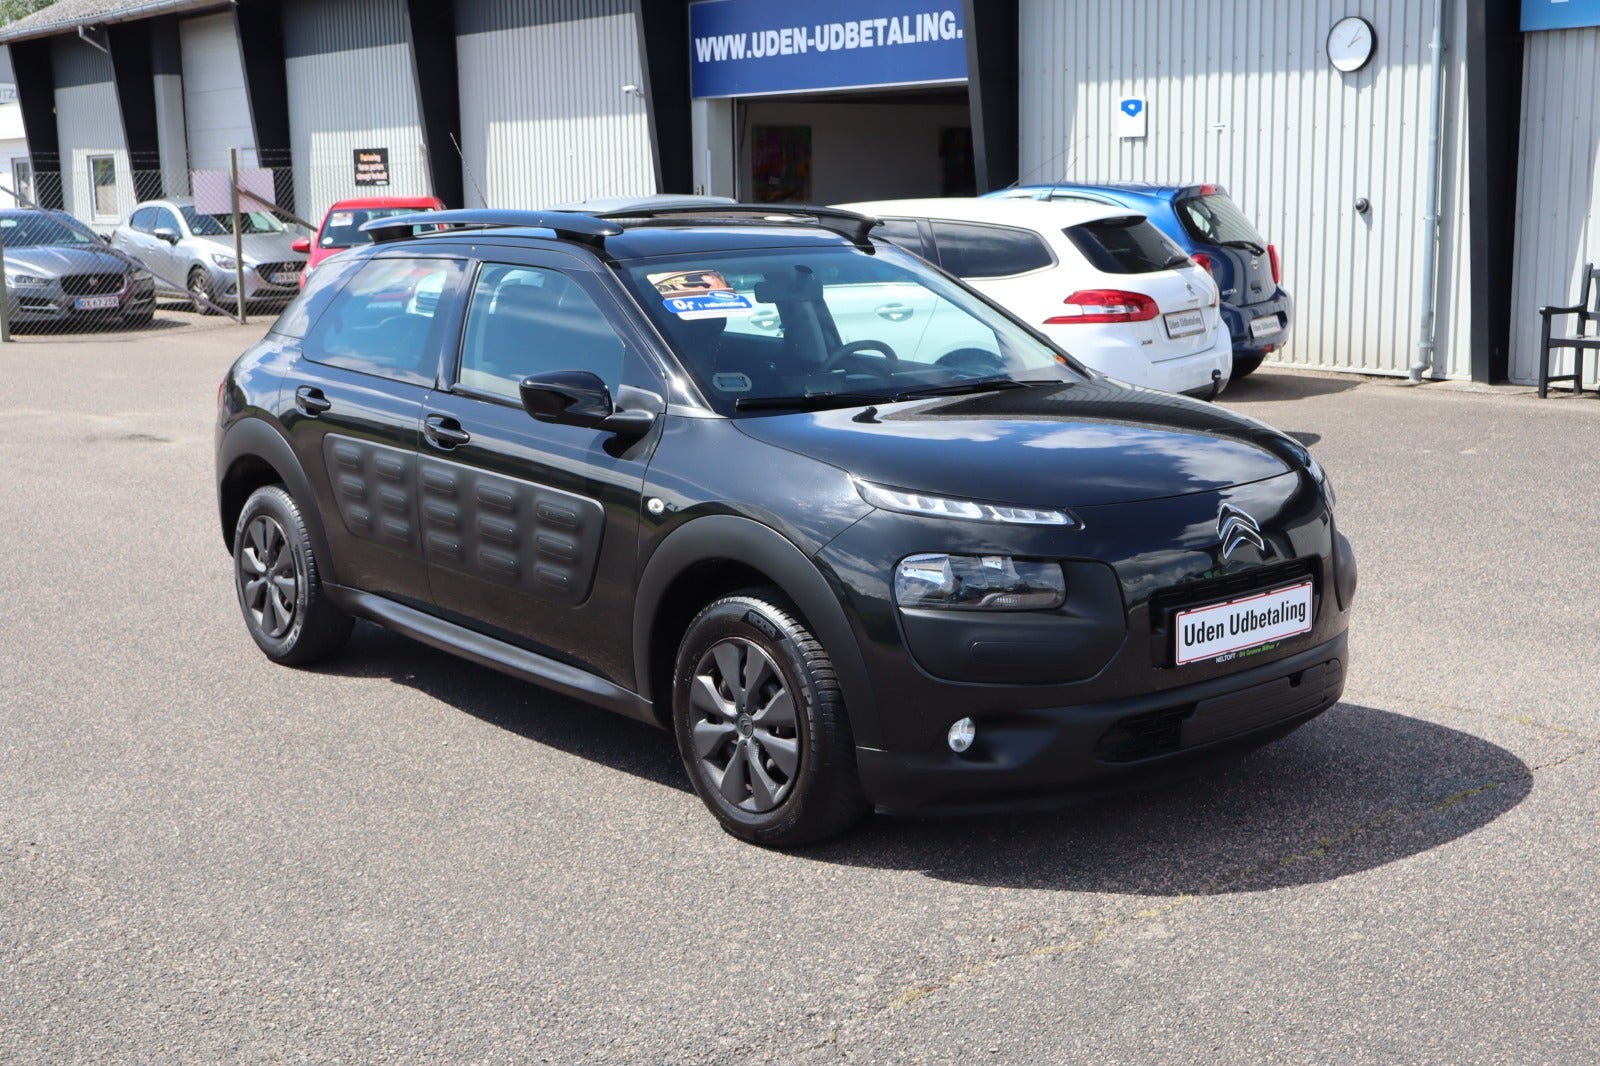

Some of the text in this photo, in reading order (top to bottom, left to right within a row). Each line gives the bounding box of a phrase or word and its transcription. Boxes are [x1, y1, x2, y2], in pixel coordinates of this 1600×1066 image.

[696, 10, 963, 63] WWW.UDEN-UDBETALING.
[1184, 600, 1306, 647] Uden Udbetaling
[1215, 652, 1236, 664] NELTOFT
